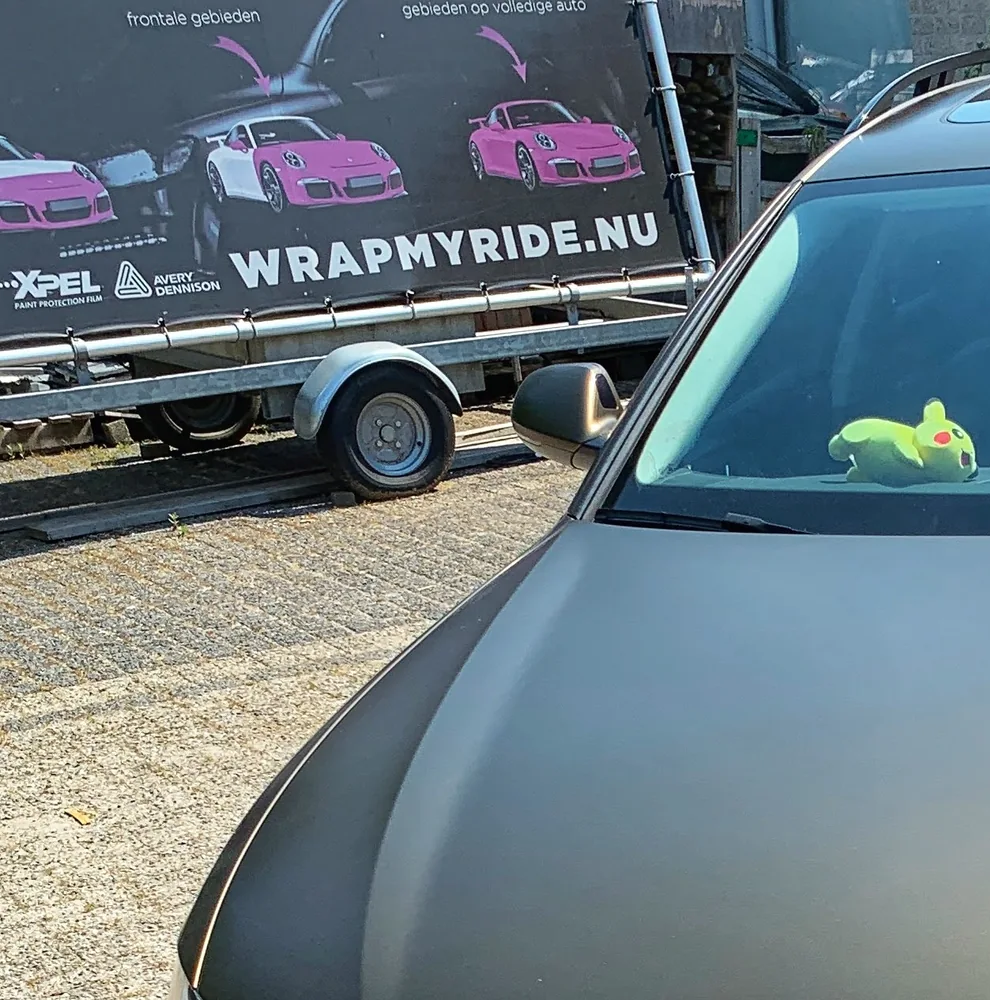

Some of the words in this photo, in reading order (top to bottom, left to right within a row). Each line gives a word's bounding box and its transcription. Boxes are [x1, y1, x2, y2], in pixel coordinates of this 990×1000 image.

[126, 11, 188, 27] frontale
[190, 9, 261, 27] gebieden
[402, 2, 468, 19] gebieden
[470, 3, 489, 16] op
[497, 0, 553, 14] volledige
[556, 0, 587, 12] auto
[228, 211, 659, 289] WRAPMYRIDE.NU
[11, 269, 102, 300] XPEL
[153, 272, 194, 286] AVERY
[155, 281, 221, 297] DENNISON
[14, 301, 38, 310] PAINT
[39, 297, 86, 308] PROTECTION
[86, 295, 103, 304] FILM
